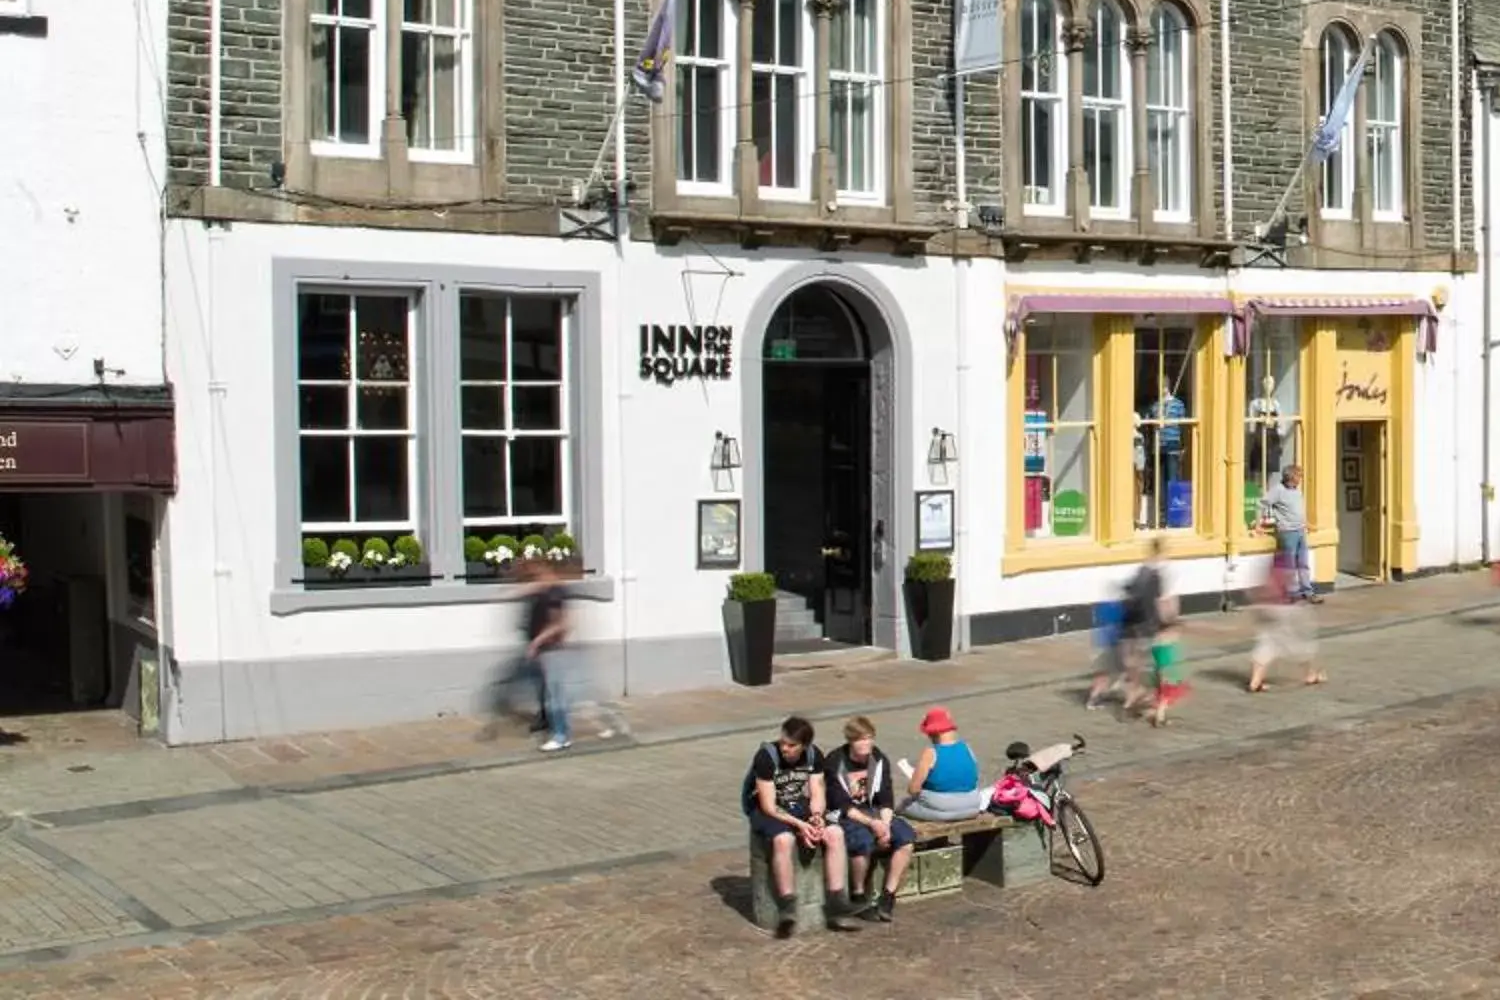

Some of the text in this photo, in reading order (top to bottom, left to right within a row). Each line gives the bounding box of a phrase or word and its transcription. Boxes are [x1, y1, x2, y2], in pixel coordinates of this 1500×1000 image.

[639, 323, 732, 356] INN ON
[704, 341, 732, 355] THE
[639, 356, 732, 388] SQUARE
